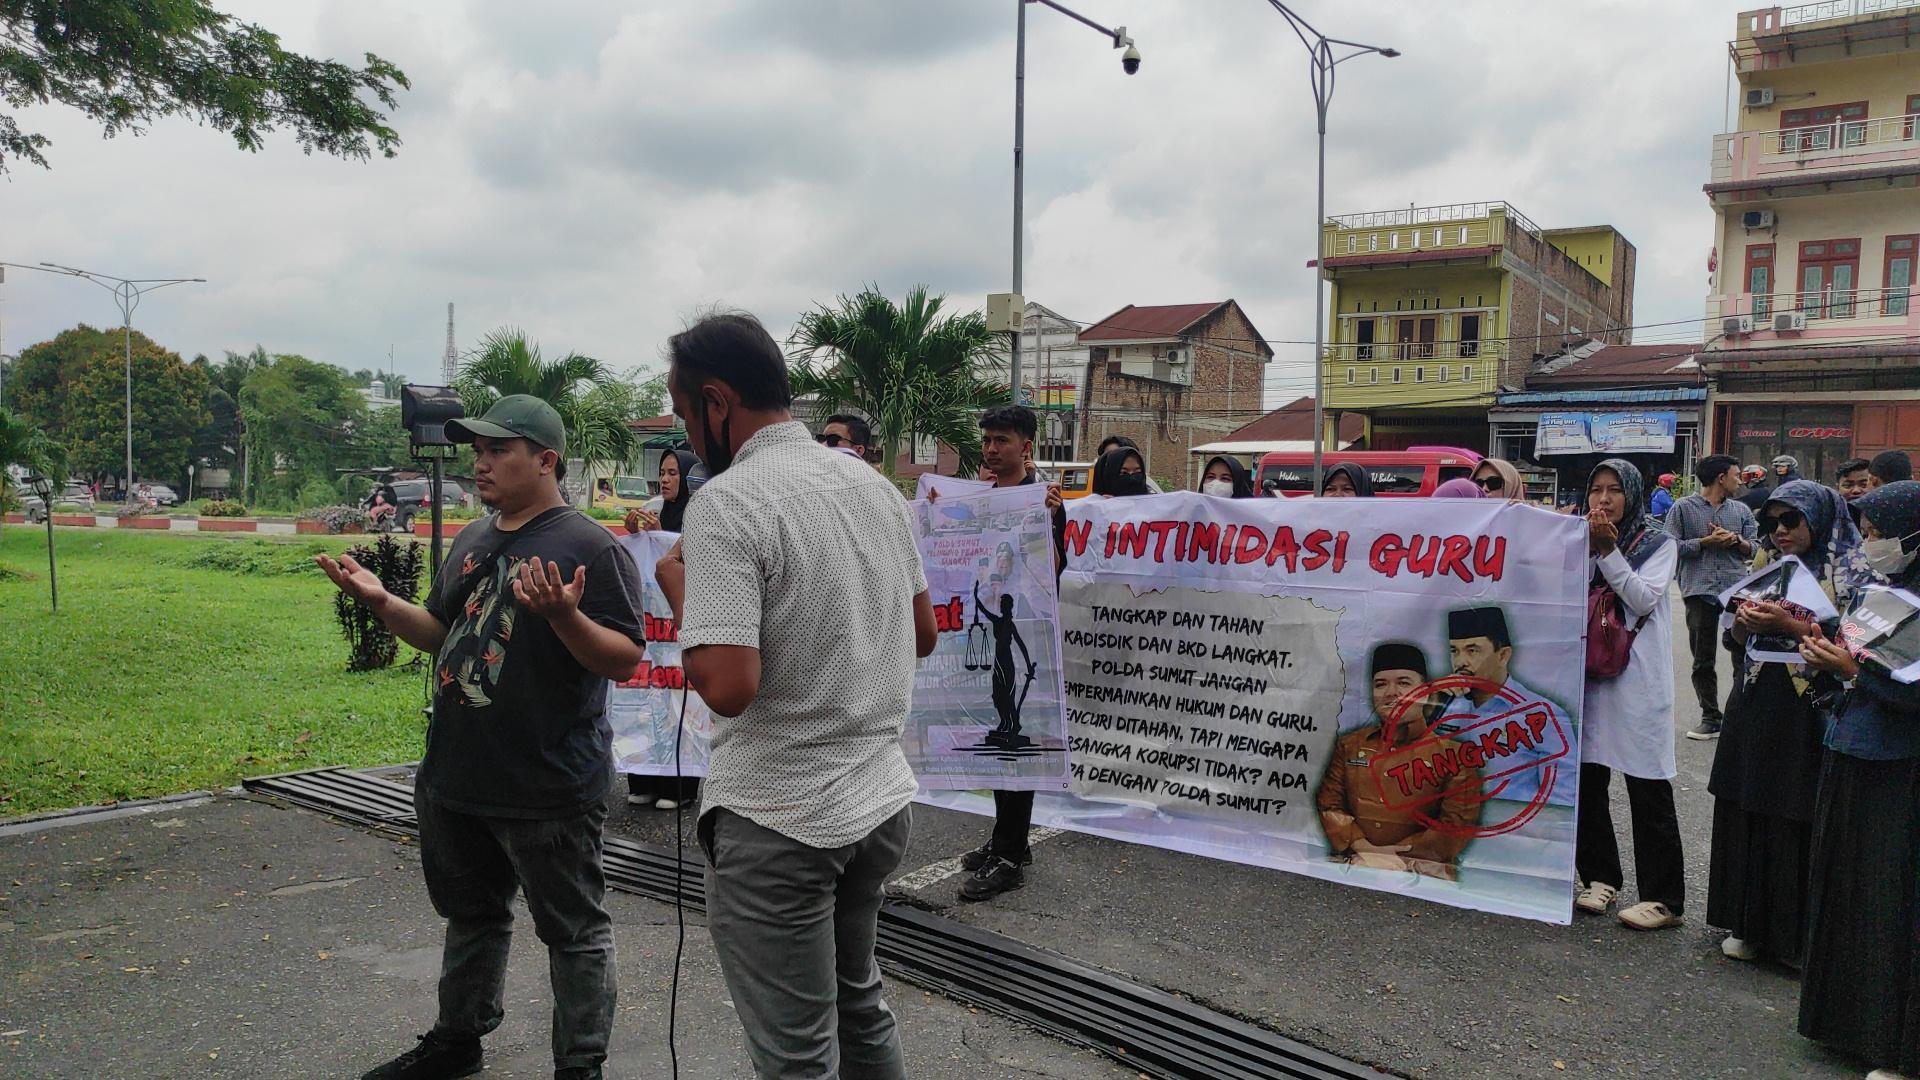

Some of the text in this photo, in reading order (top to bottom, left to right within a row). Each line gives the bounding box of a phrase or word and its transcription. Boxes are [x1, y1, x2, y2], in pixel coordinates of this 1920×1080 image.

[1279, 471, 1300, 481] Medan
[1104, 520, 1350, 574] INTIMIDASI
[1369, 533, 1507, 583] GURU
[1092, 605, 1264, 636] TANGKAP DAN TAHAN
[1065, 630, 1293, 669] KADISDIK DAN BKD LANGKAT.
[1092, 659, 1267, 696] POLDA SUMUT JANGAN
[1176, 696, 1225, 719] HUKUM
[1230, 704, 1263, 725] DAN
[1267, 711, 1317, 733] GURU.
[1116, 717, 1183, 742] DITAHAN,
[1190, 727, 1223, 748] TAPI
[1226, 734, 1308, 762] MENGAPA
[1387, 711, 1548, 797] TANGKAP
[1136, 747, 1200, 774] KORUPSI
[1204, 759, 1262, 785] TIDAK?
[1267, 771, 1307, 792] ADA
[1089, 767, 1158, 793] DENGAN
[1216, 792, 1287, 815] SUMUT?
